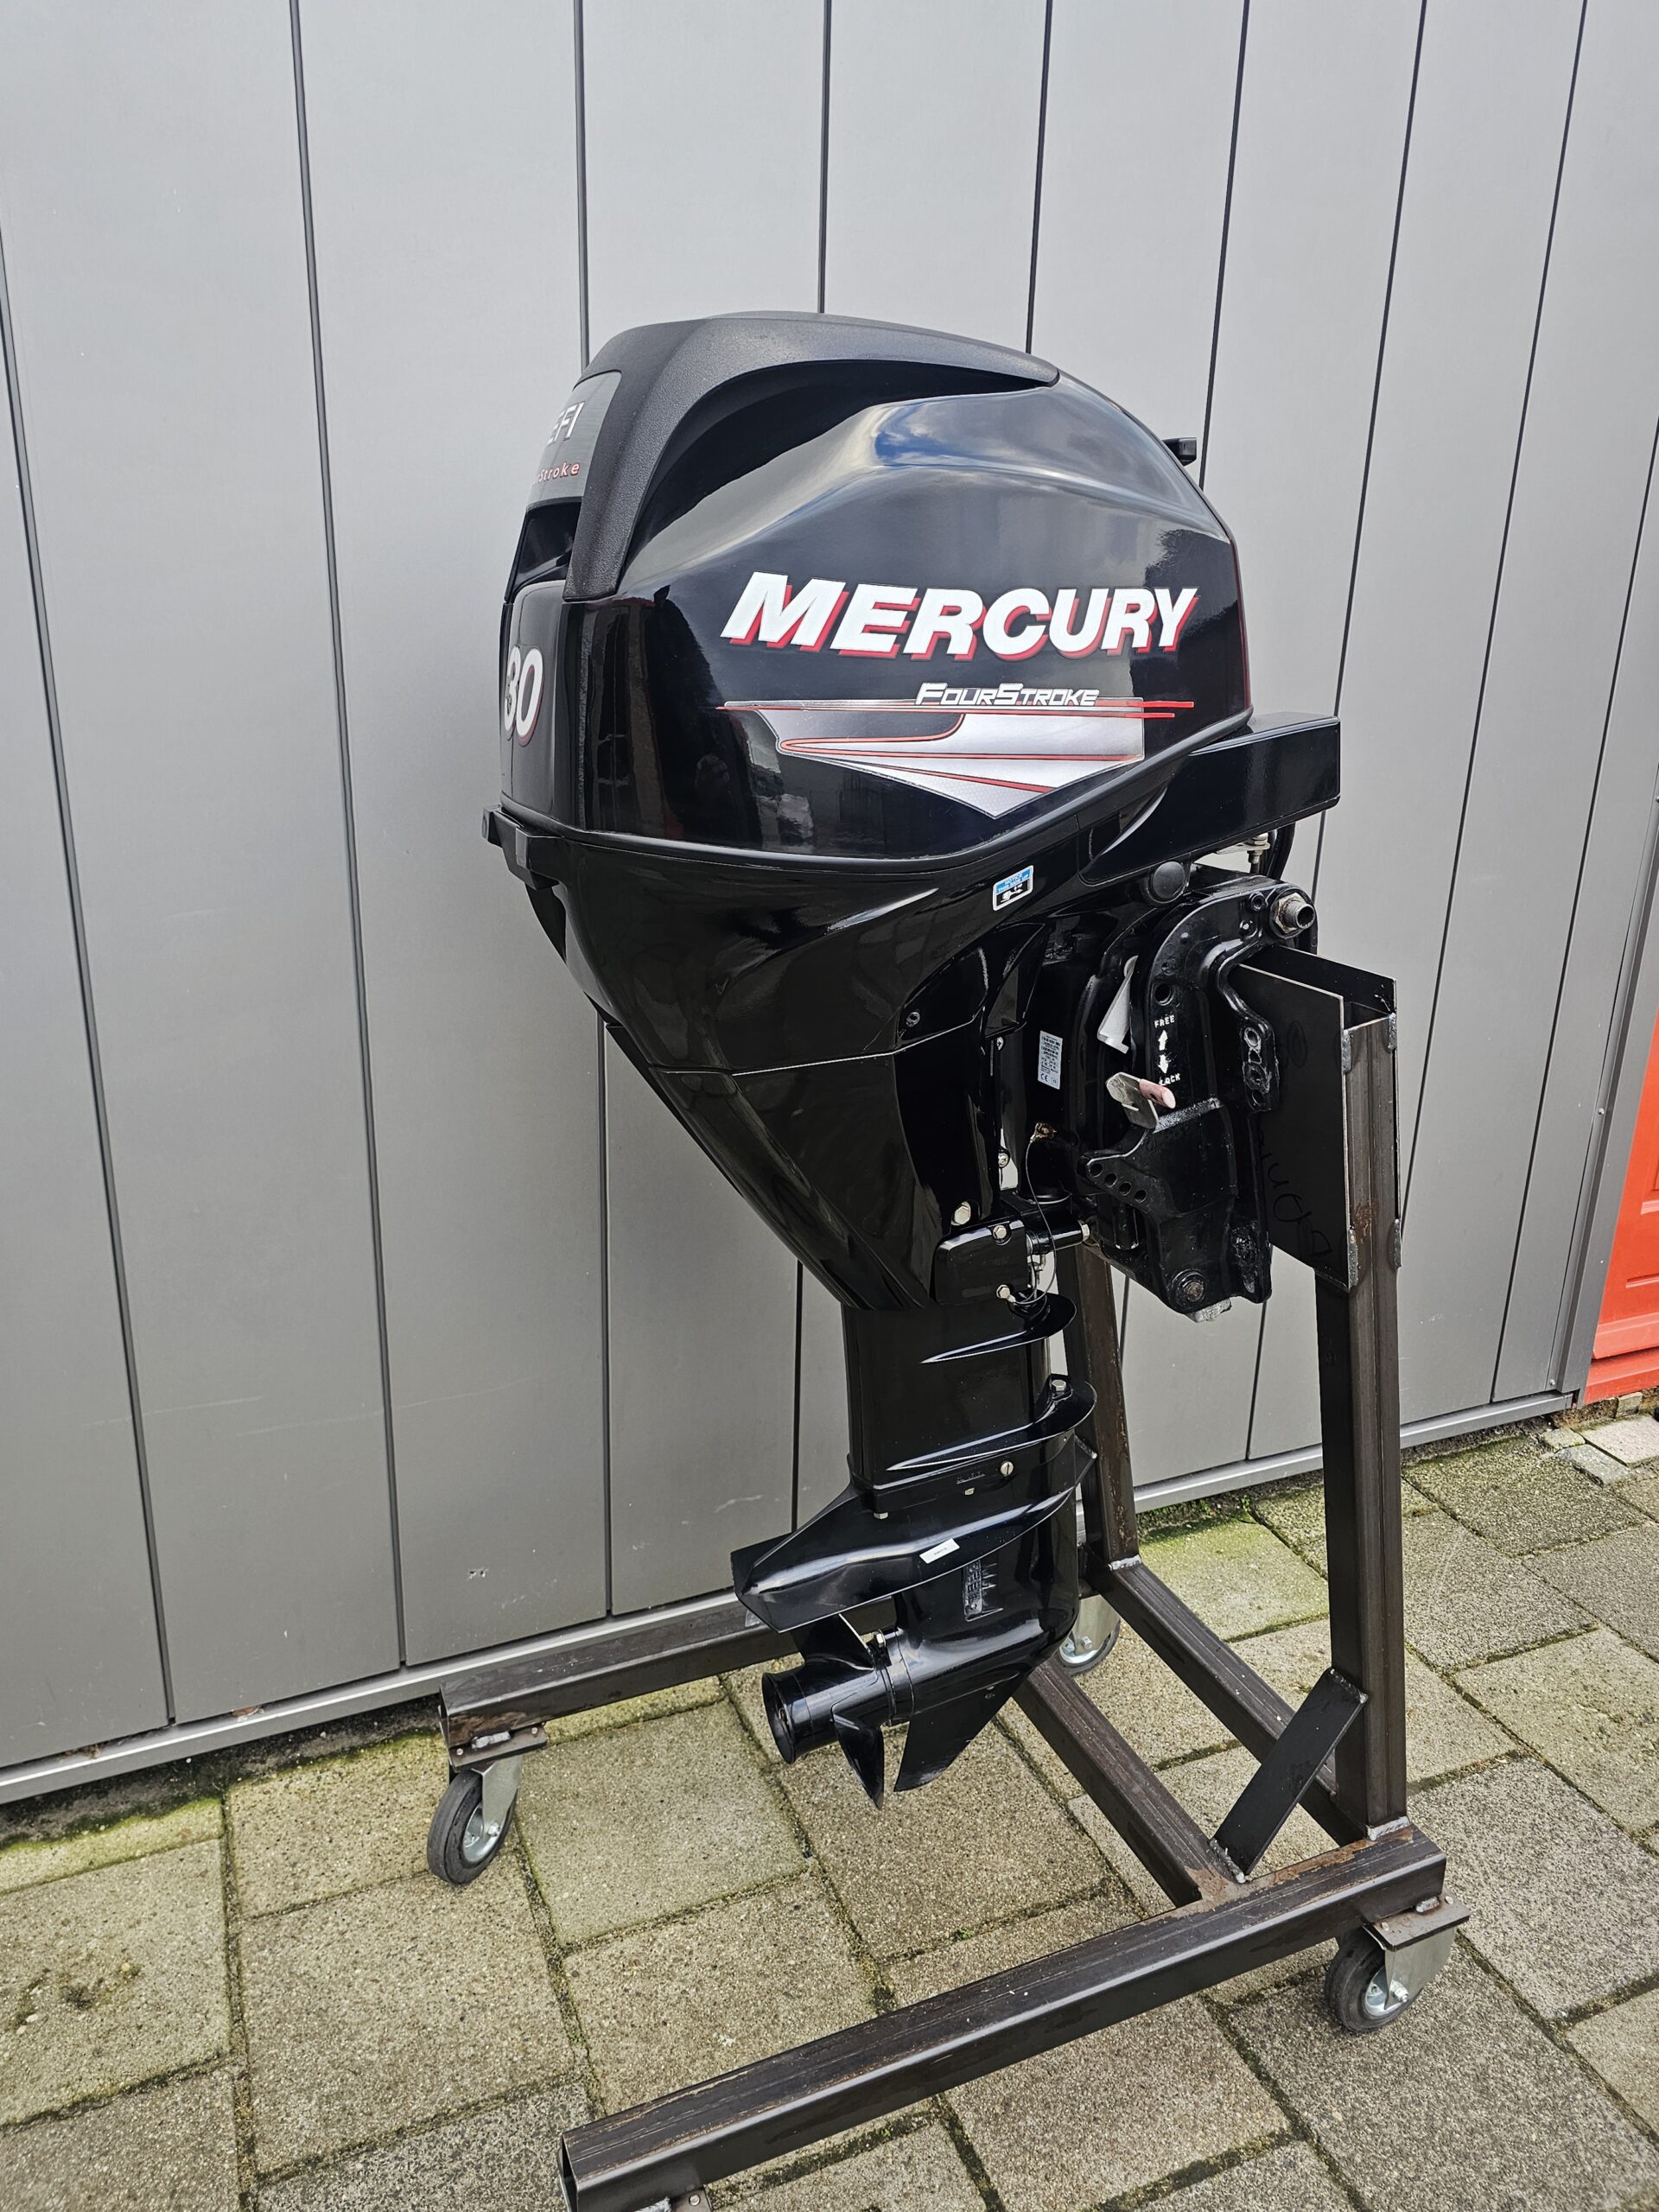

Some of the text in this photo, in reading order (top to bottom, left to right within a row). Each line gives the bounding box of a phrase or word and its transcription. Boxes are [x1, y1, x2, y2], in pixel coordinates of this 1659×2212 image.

[533, 461, 581, 485] Stroke
[720, 571, 1199, 660] MERCURY
[504, 645, 544, 747] 30
[1154, 1014, 1176, 1028] FREE
